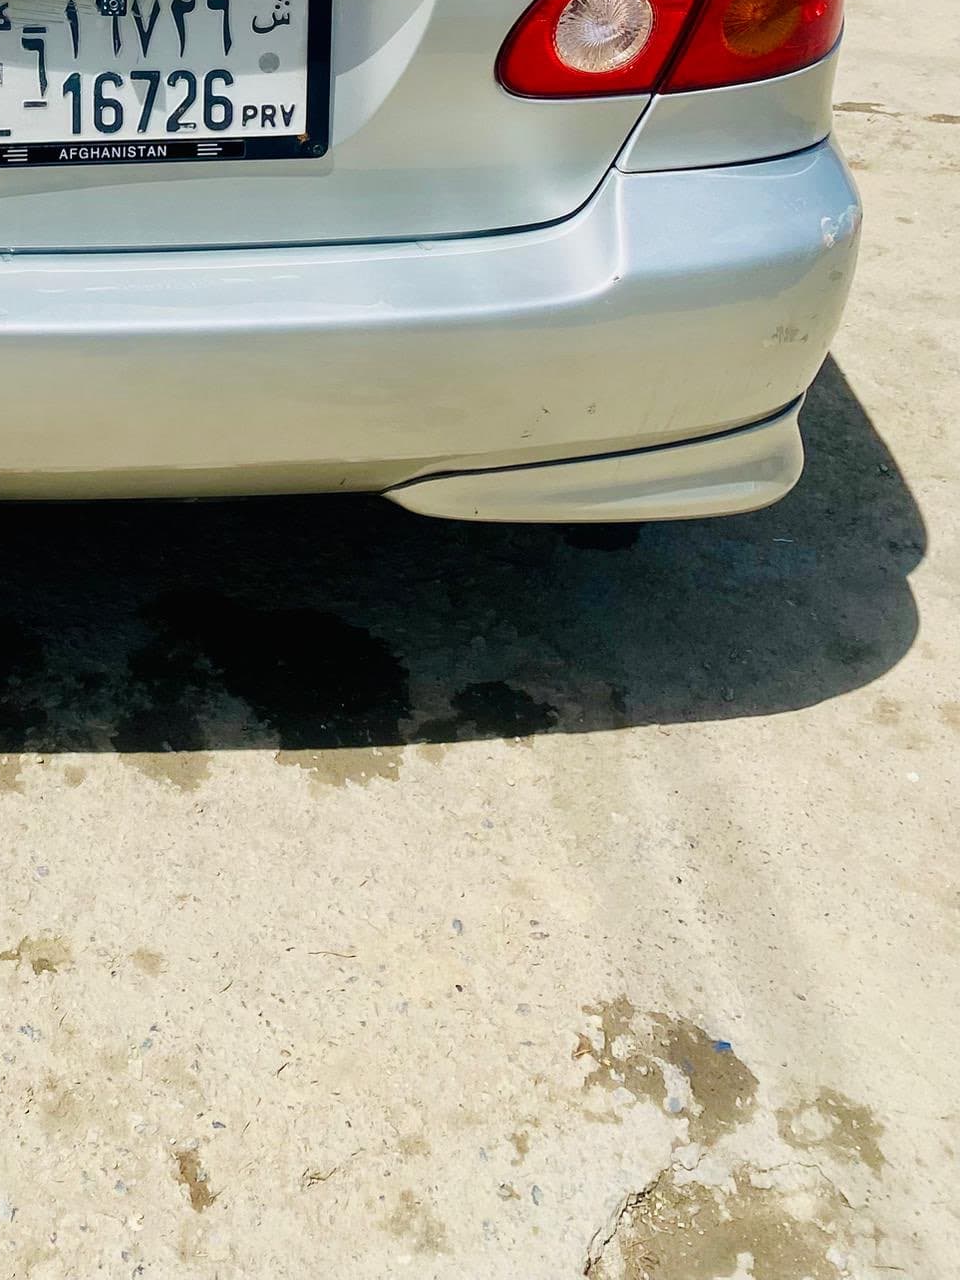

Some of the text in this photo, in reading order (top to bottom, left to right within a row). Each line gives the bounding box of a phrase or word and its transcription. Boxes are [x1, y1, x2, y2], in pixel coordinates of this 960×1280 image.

[62, 70, 235, 135] 16726
[242, 104, 296, 128] PRV
[59, 145, 168, 160] AFGHANISTAN
